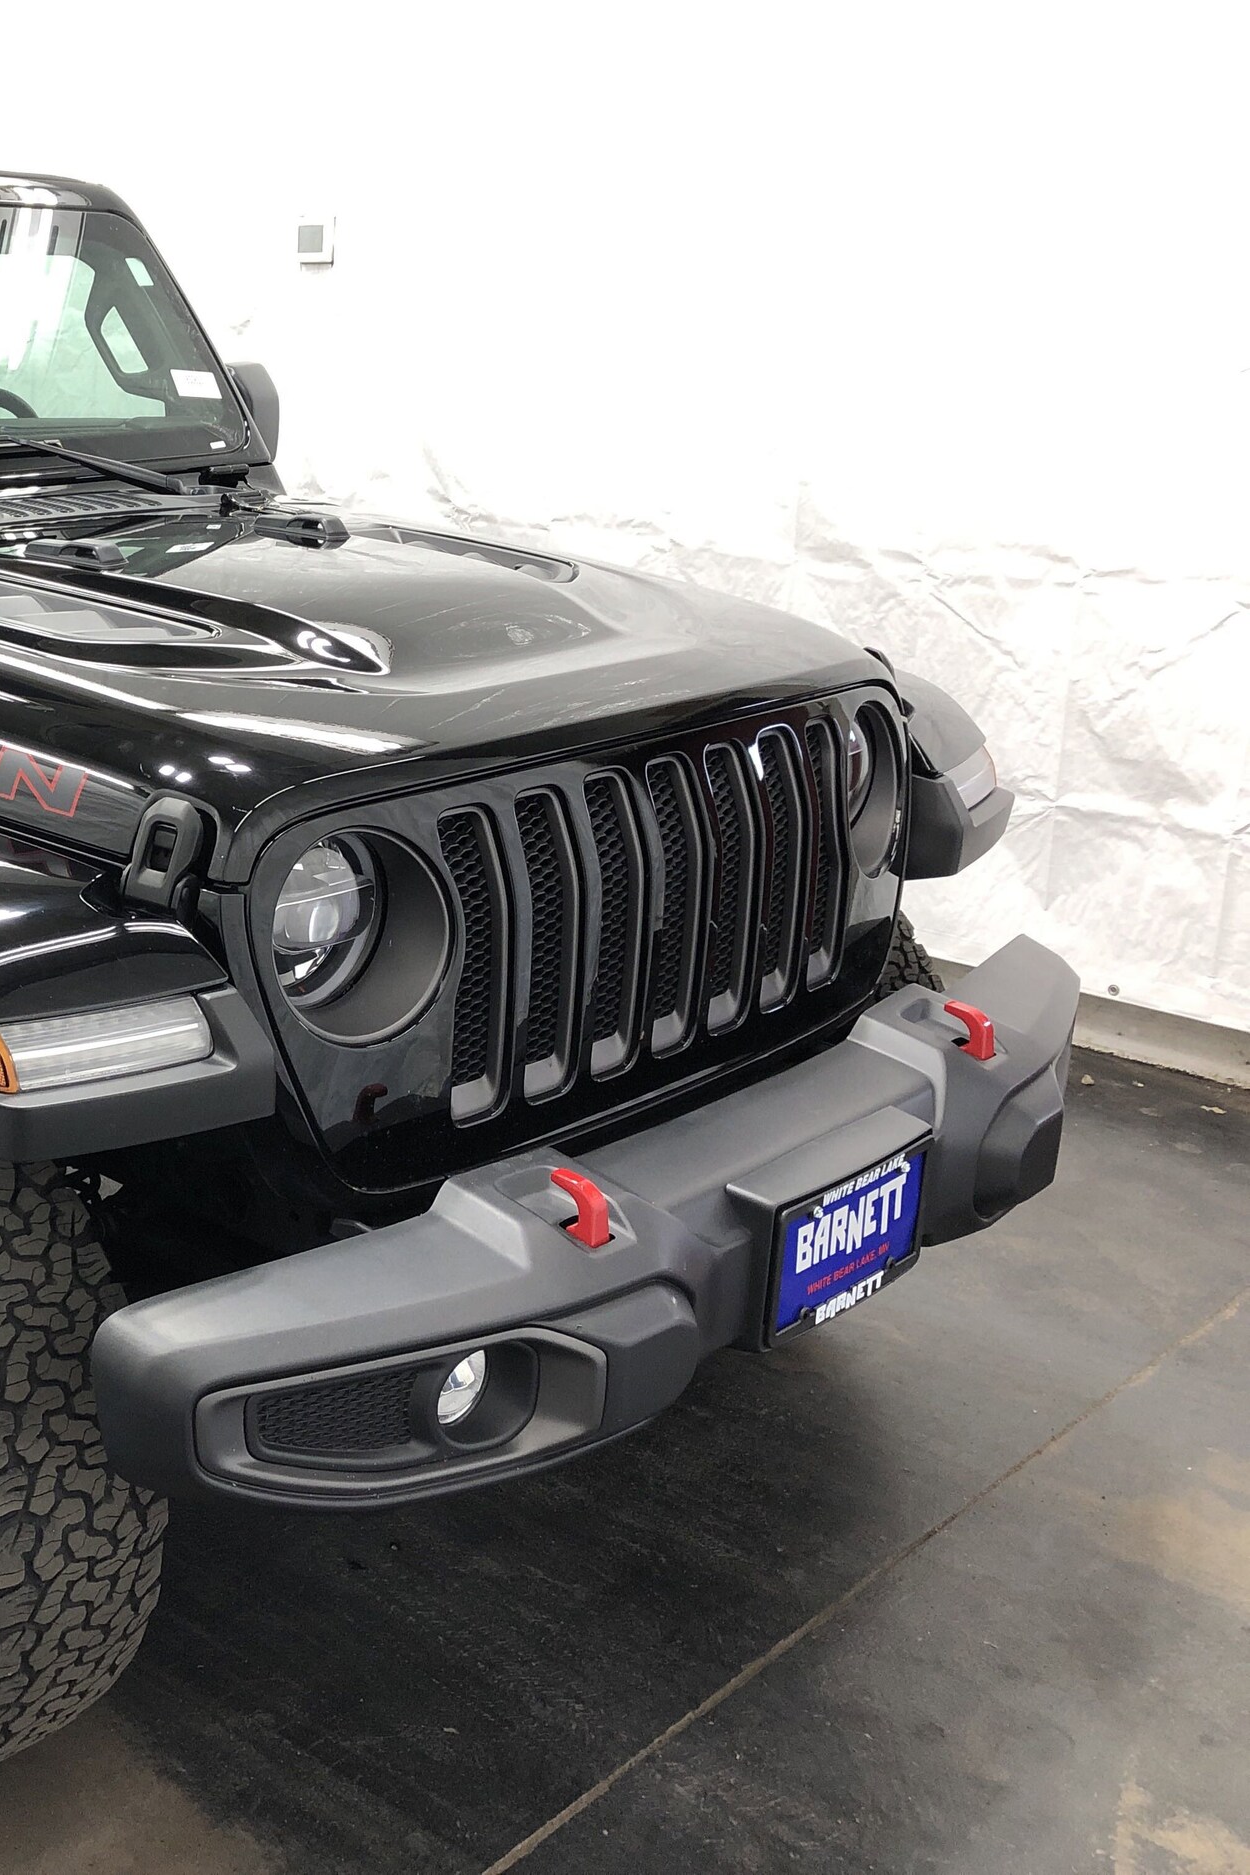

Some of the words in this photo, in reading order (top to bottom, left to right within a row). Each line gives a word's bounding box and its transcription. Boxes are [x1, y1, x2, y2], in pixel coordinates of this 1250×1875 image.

[823, 1181, 855, 1207] WHITE
[855, 1167, 881, 1191] BEAR
[880, 1153, 906, 1177] LAKE
[795, 1173, 908, 1274] BARNETT
[807, 1274, 832, 1295] WHITE
[833, 1262, 855, 1281] BEAR
[815, 1270, 885, 1325] BARNETT
